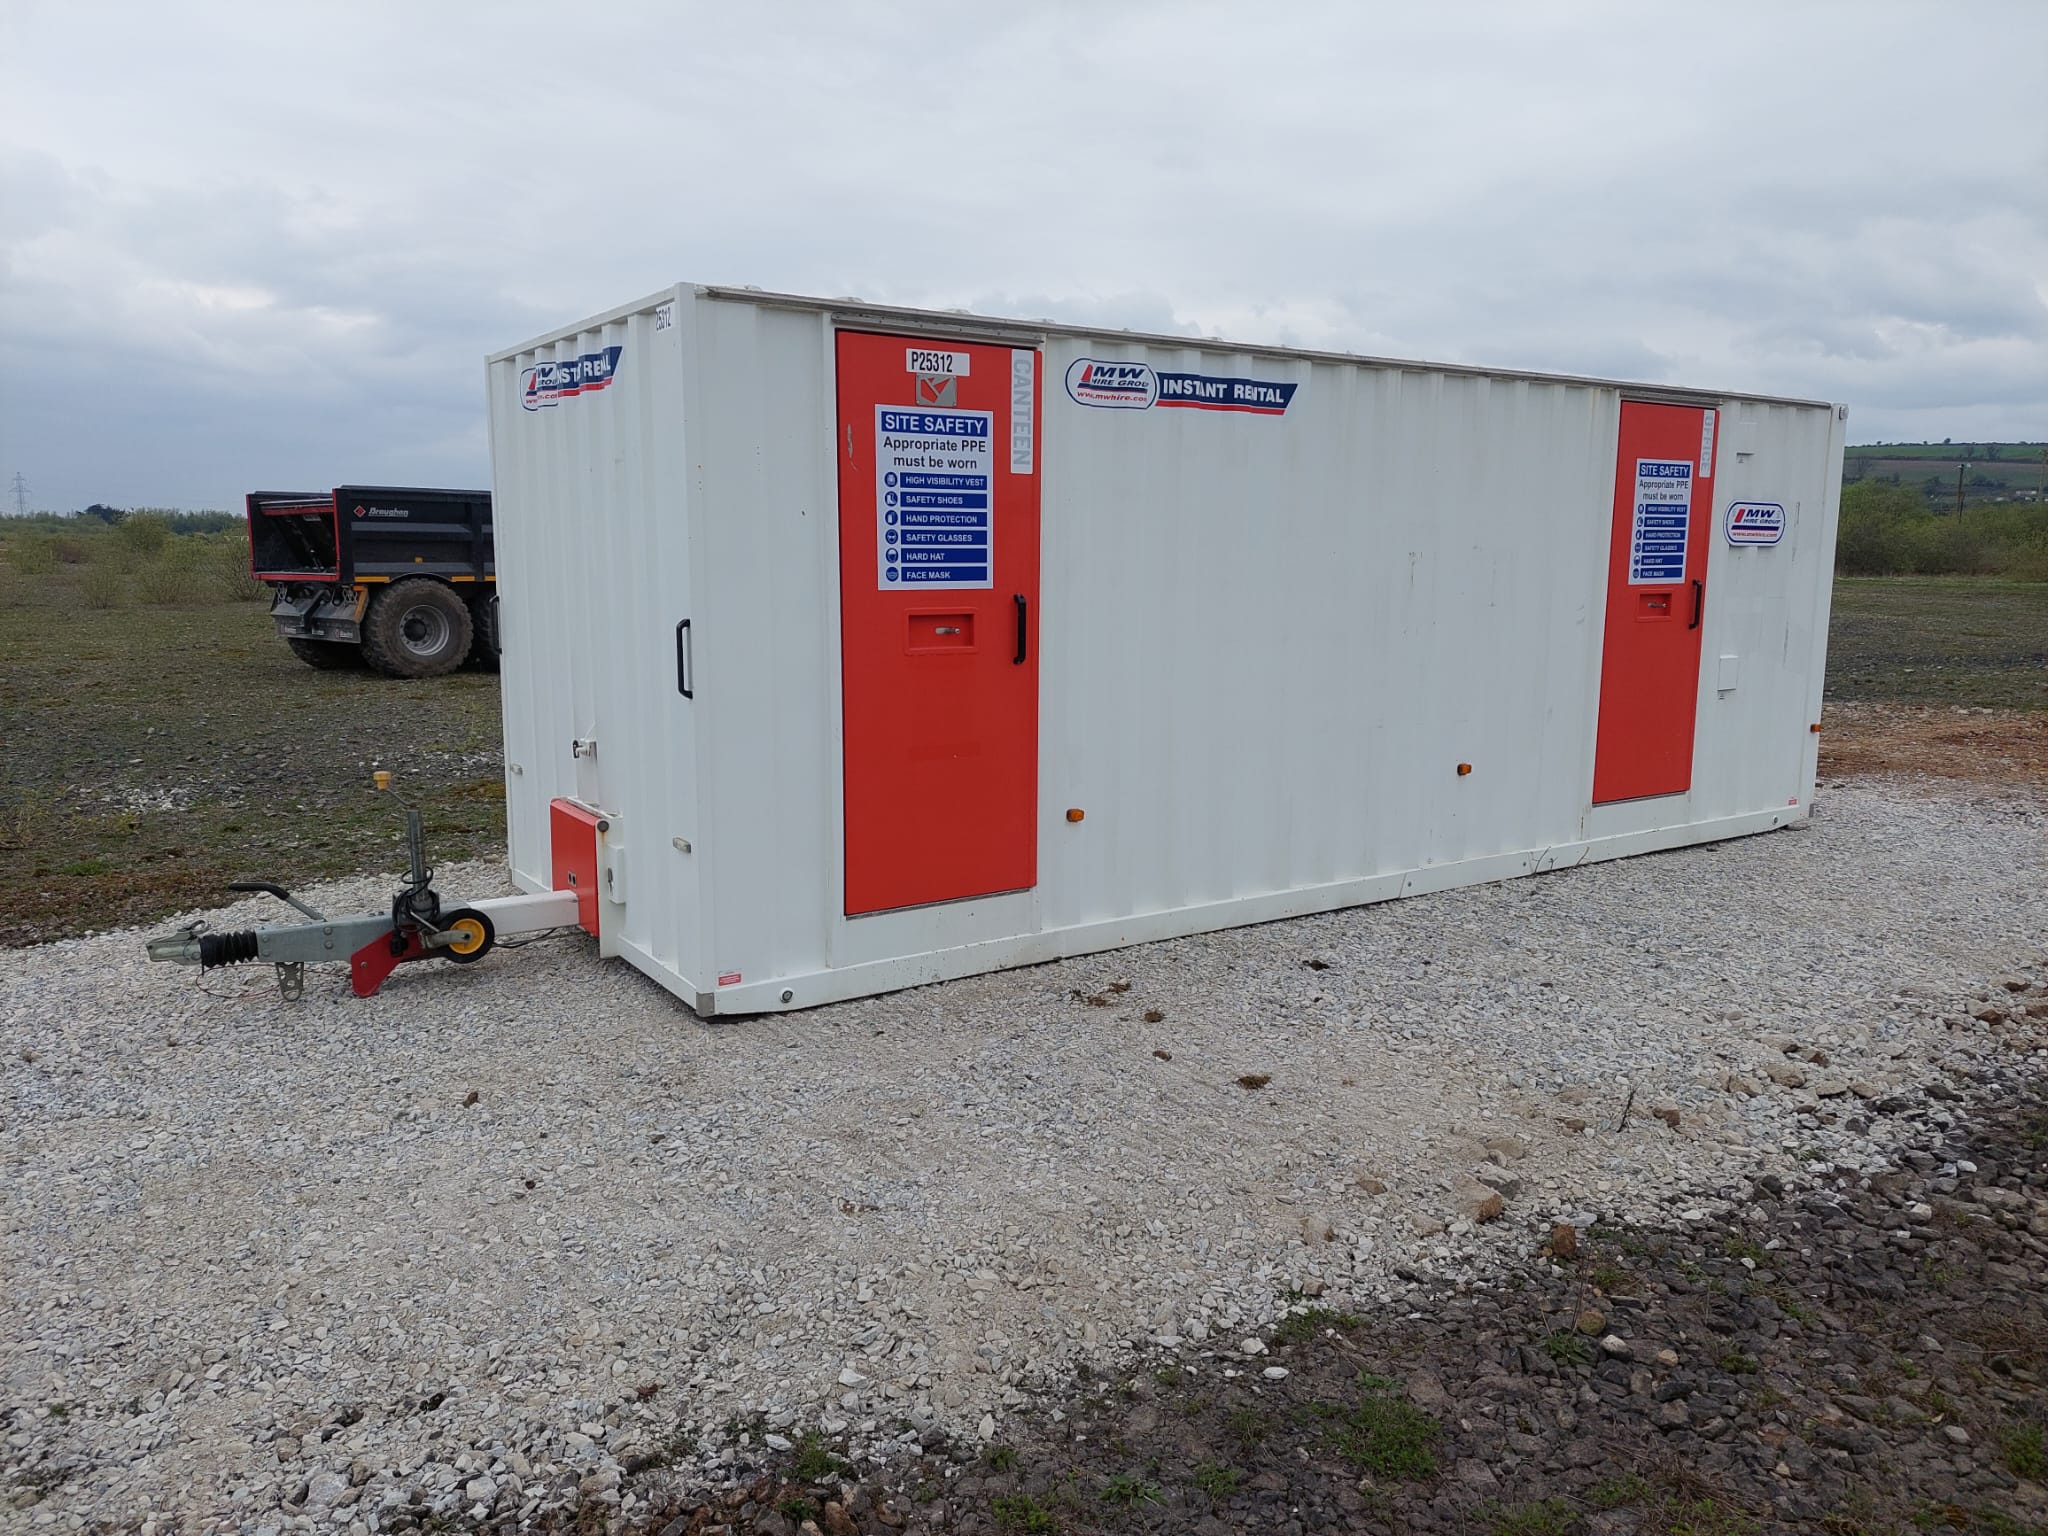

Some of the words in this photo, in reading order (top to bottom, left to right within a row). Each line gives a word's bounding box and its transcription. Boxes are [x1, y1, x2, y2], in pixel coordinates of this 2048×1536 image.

[911, 351, 953, 373] P25312
[1093, 366, 1145, 379] MW
[1163, 379, 1228, 399] INSTANT
[1233, 383, 1285, 403] RENTAL
[1013, 358, 1032, 466] CANTEEN
[884, 414, 920, 431] SITE
[924, 417, 984, 434] SAFETY
[883, 436, 958, 454] Appropriate
[961, 439, 986, 453] PPE
[893, 456, 926, 468] must
[928, 454, 944, 468] be
[949, 460, 977, 469] worn
[1640, 464, 1658, 476] SITE
[1659, 466, 1690, 478] SAFETY
[905, 476, 925, 484] HIGH
[926, 476, 963, 486] VISIBILITY
[965, 478, 985, 487] VEST
[1639, 479, 1675, 490] Appropriate
[1676, 480, 1689, 490] PPE
[905, 495, 935, 504] SAFETY
[937, 496, 964, 505] SHOES
[1642, 492, 1659, 501] must
[1659, 492, 1668, 501] be
[905, 514, 928, 523] HAND
[929, 515, 978, 524] PROTECTION
[1746, 509, 1776, 519] MW
[906, 533, 936, 542] SAFETY
[937, 534, 973, 542] GLASSES
[906, 552, 929, 561] HARD
[930, 552, 945, 561] HAT
[906, 571, 927, 579] FACE
[928, 571, 951, 579] MASK
